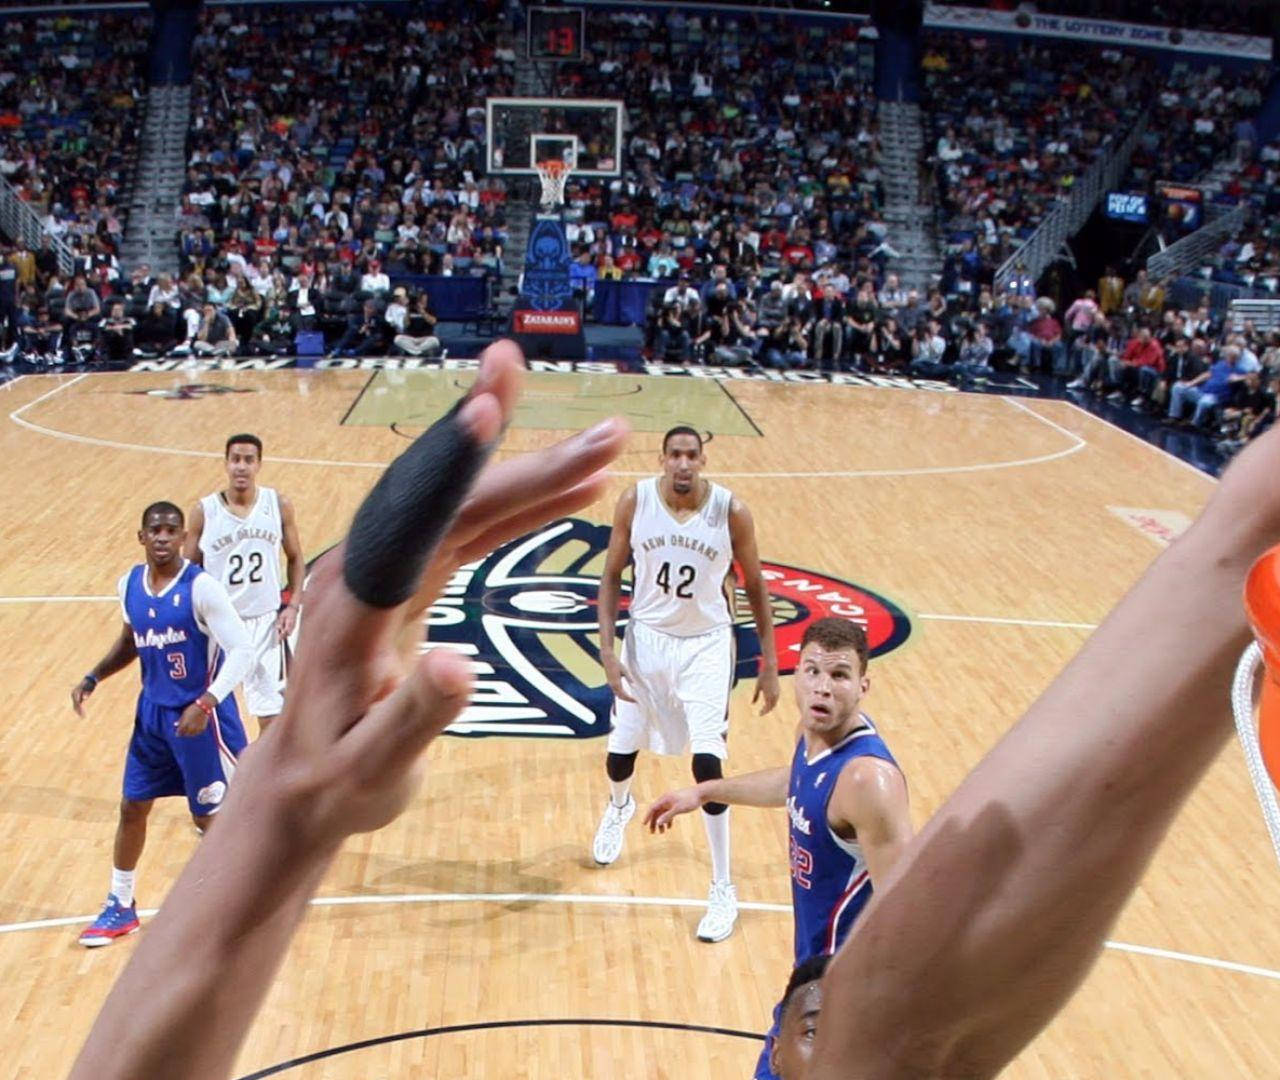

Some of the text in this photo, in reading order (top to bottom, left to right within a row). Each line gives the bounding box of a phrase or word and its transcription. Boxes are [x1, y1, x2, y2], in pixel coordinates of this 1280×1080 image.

[1034, 18, 1165, 41] THE LOTTERY ZONE
[314, 358, 618, 373] ORLENS
[642, 534, 719, 561] NEW ORLEANS
[228, 552, 263, 585] 22
[656, 561, 696, 599] 42
[167, 652, 187, 680] 3
